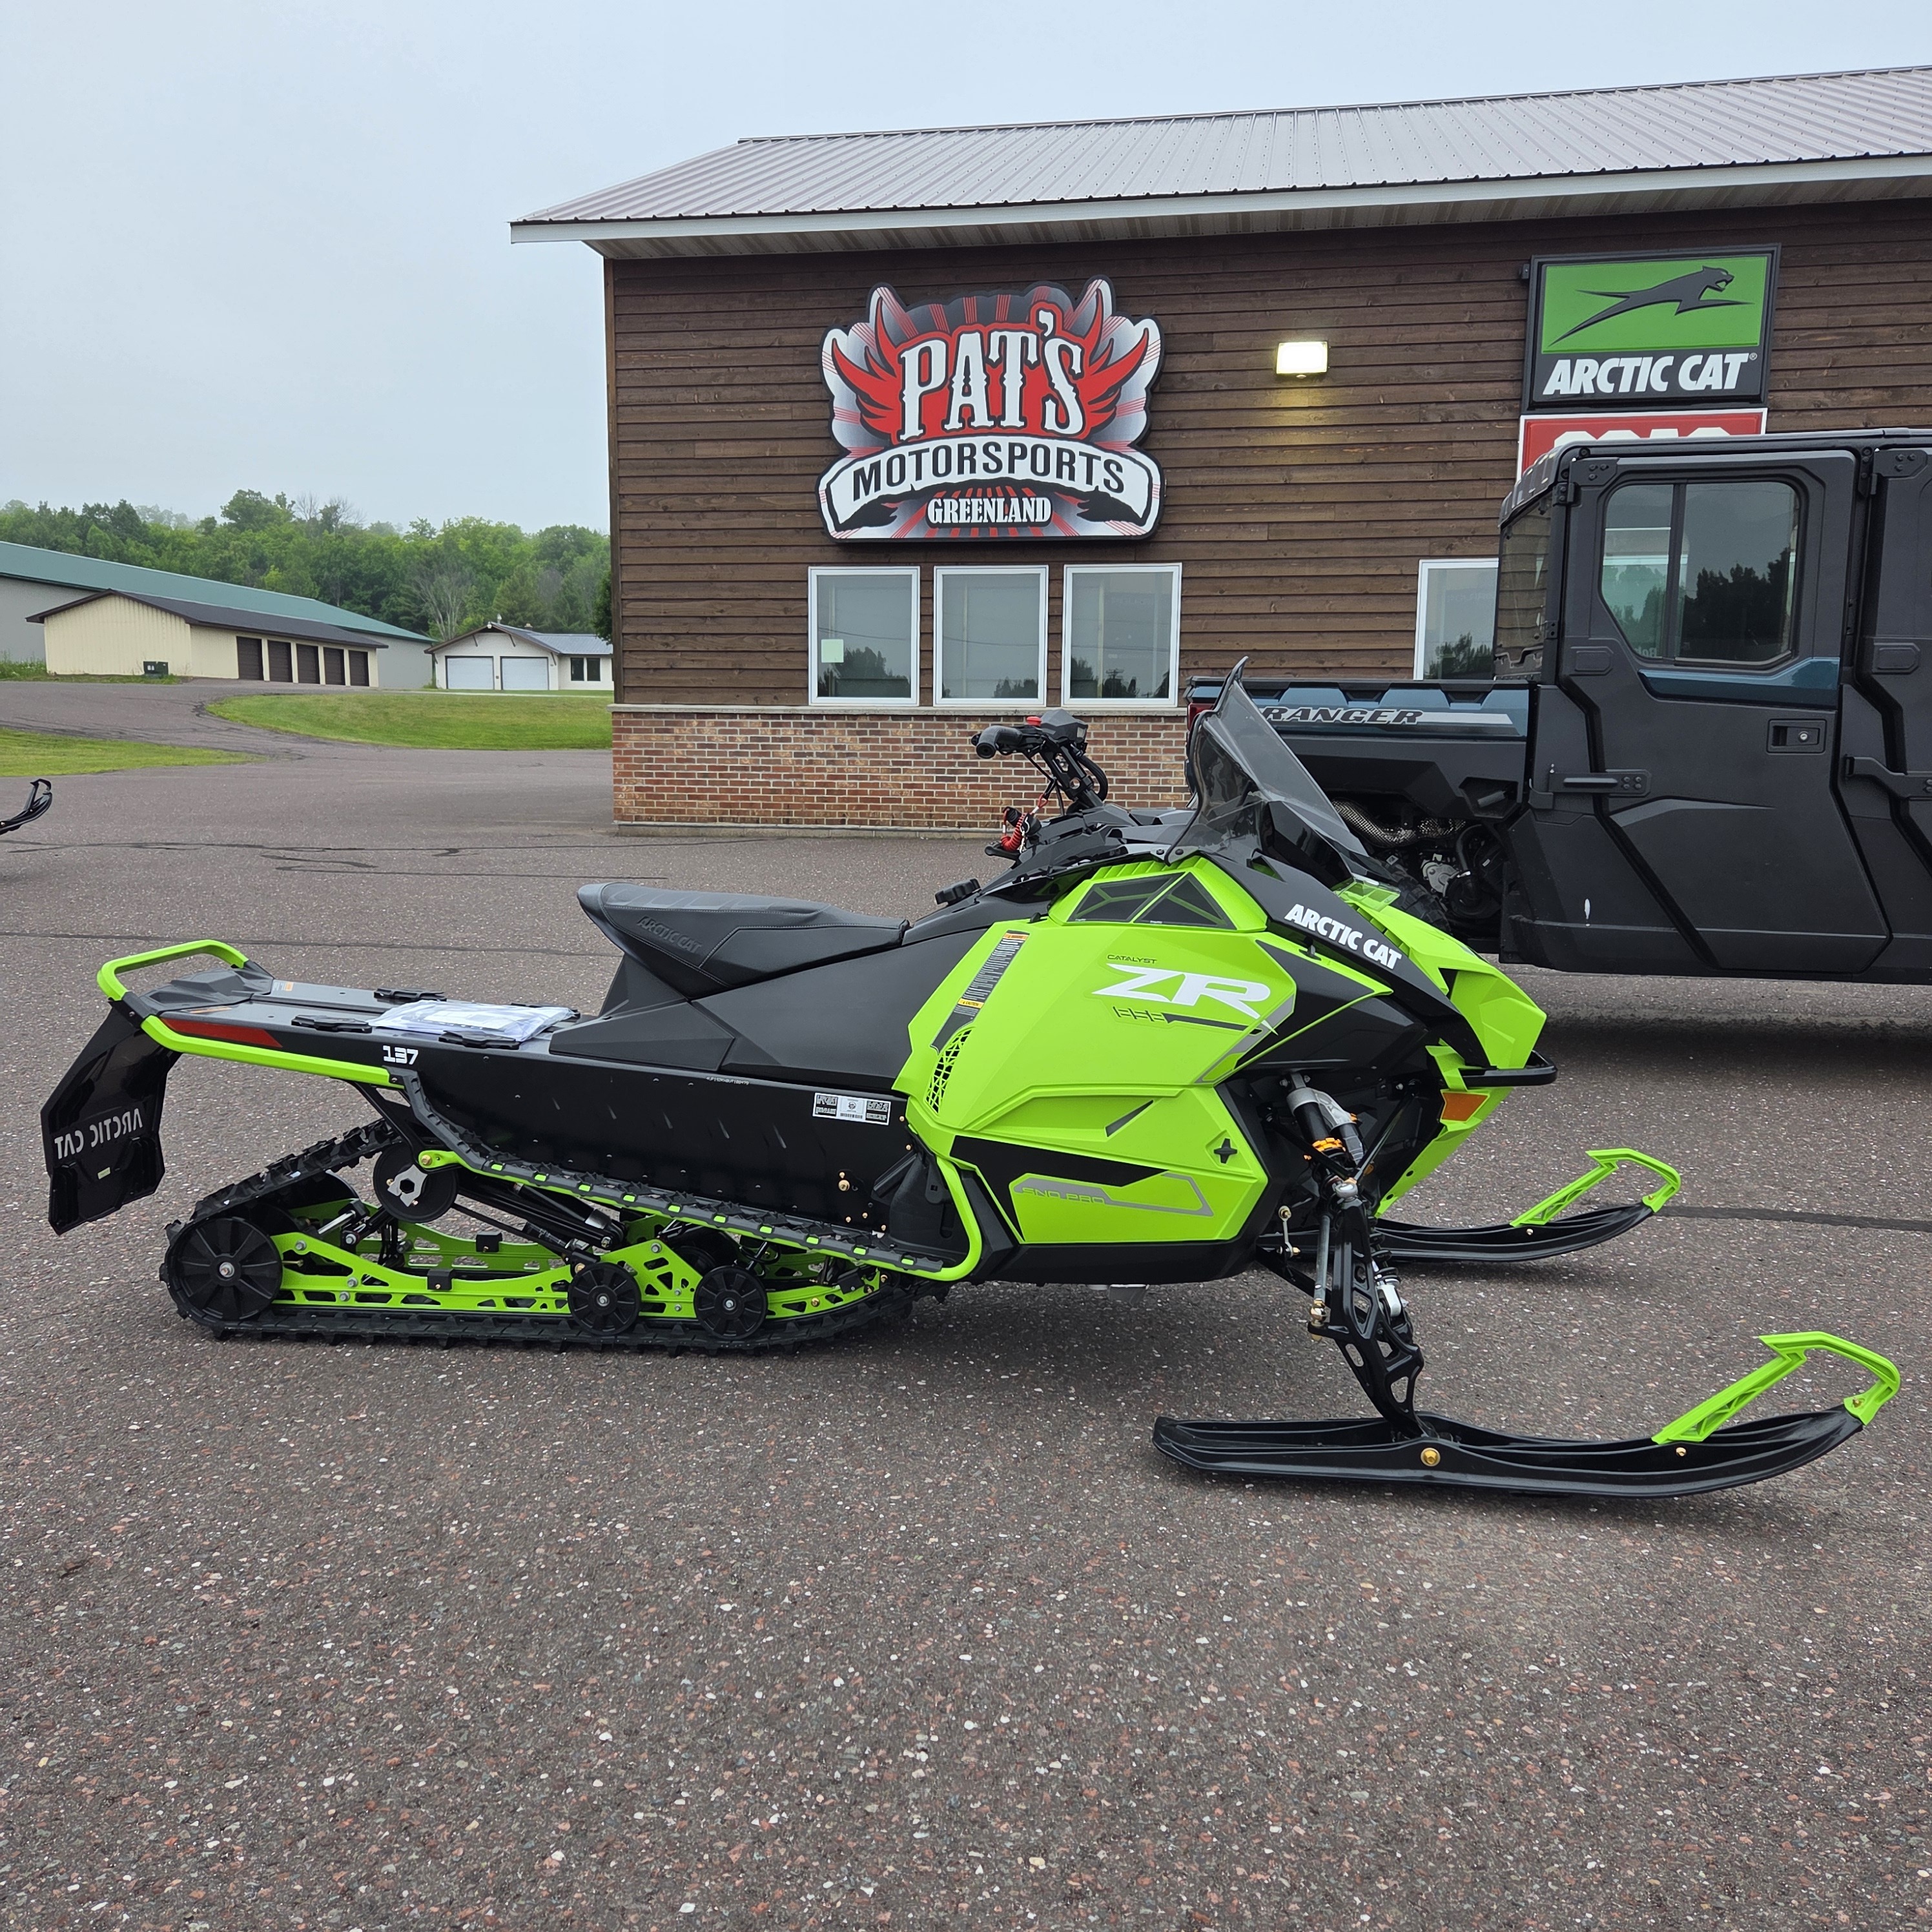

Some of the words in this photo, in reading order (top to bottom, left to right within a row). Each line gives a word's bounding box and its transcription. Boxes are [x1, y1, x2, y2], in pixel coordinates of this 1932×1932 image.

[900, 310, 1084, 440] PAT'S
[1543, 356, 1674, 395] ARCTIC
[852, 442, 1125, 501] MOTORSPORTS
[928, 497, 1051, 523] GREENLAND
[1262, 706, 1423, 724] RANGER
[637, 916, 679, 942] ARCTIC
[677, 936, 702, 953] CAT
[1284, 904, 1362, 950] ARCTIC
[1363, 939, 1402, 969] CAT
[1107, 954, 1157, 964] CATALYST
[1091, 963, 1278, 1036] ZR
[383, 1045, 418, 1065] 137
[1022, 1187, 1060, 1198] SNO
